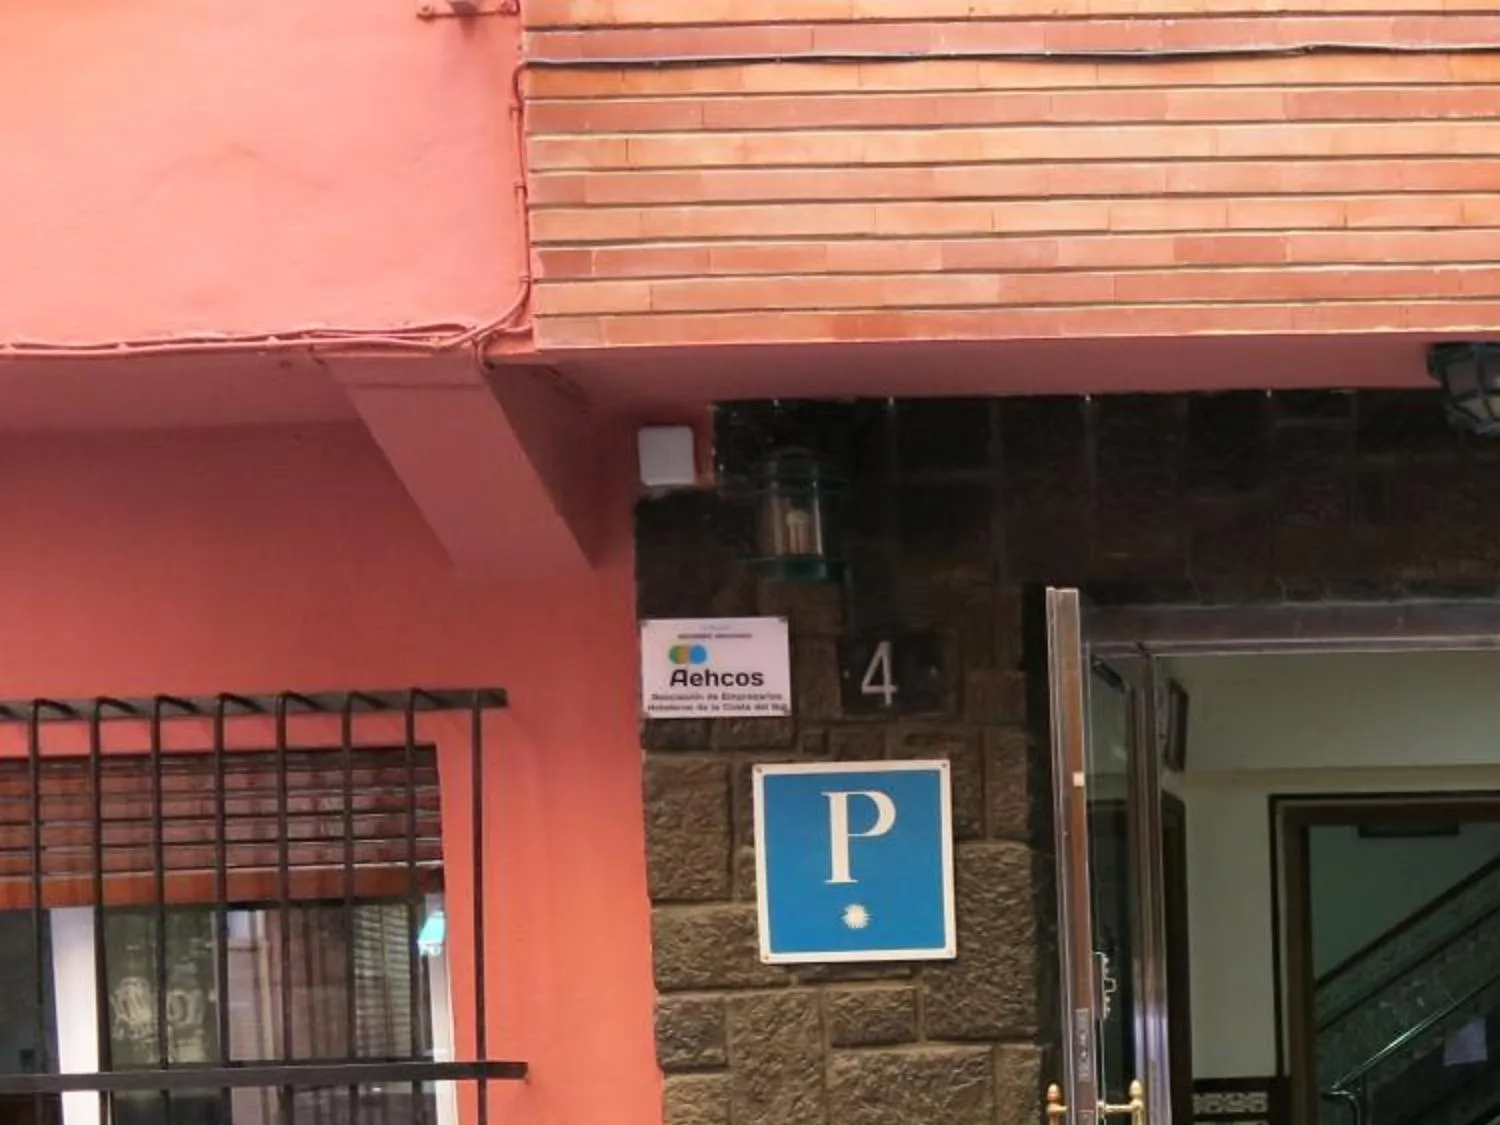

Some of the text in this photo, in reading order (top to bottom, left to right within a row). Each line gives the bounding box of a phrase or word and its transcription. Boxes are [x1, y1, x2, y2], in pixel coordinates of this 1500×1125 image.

[669, 668, 765, 687] Aehcos
[860, 640, 898, 708] 4
[820, 790, 897, 885] P
